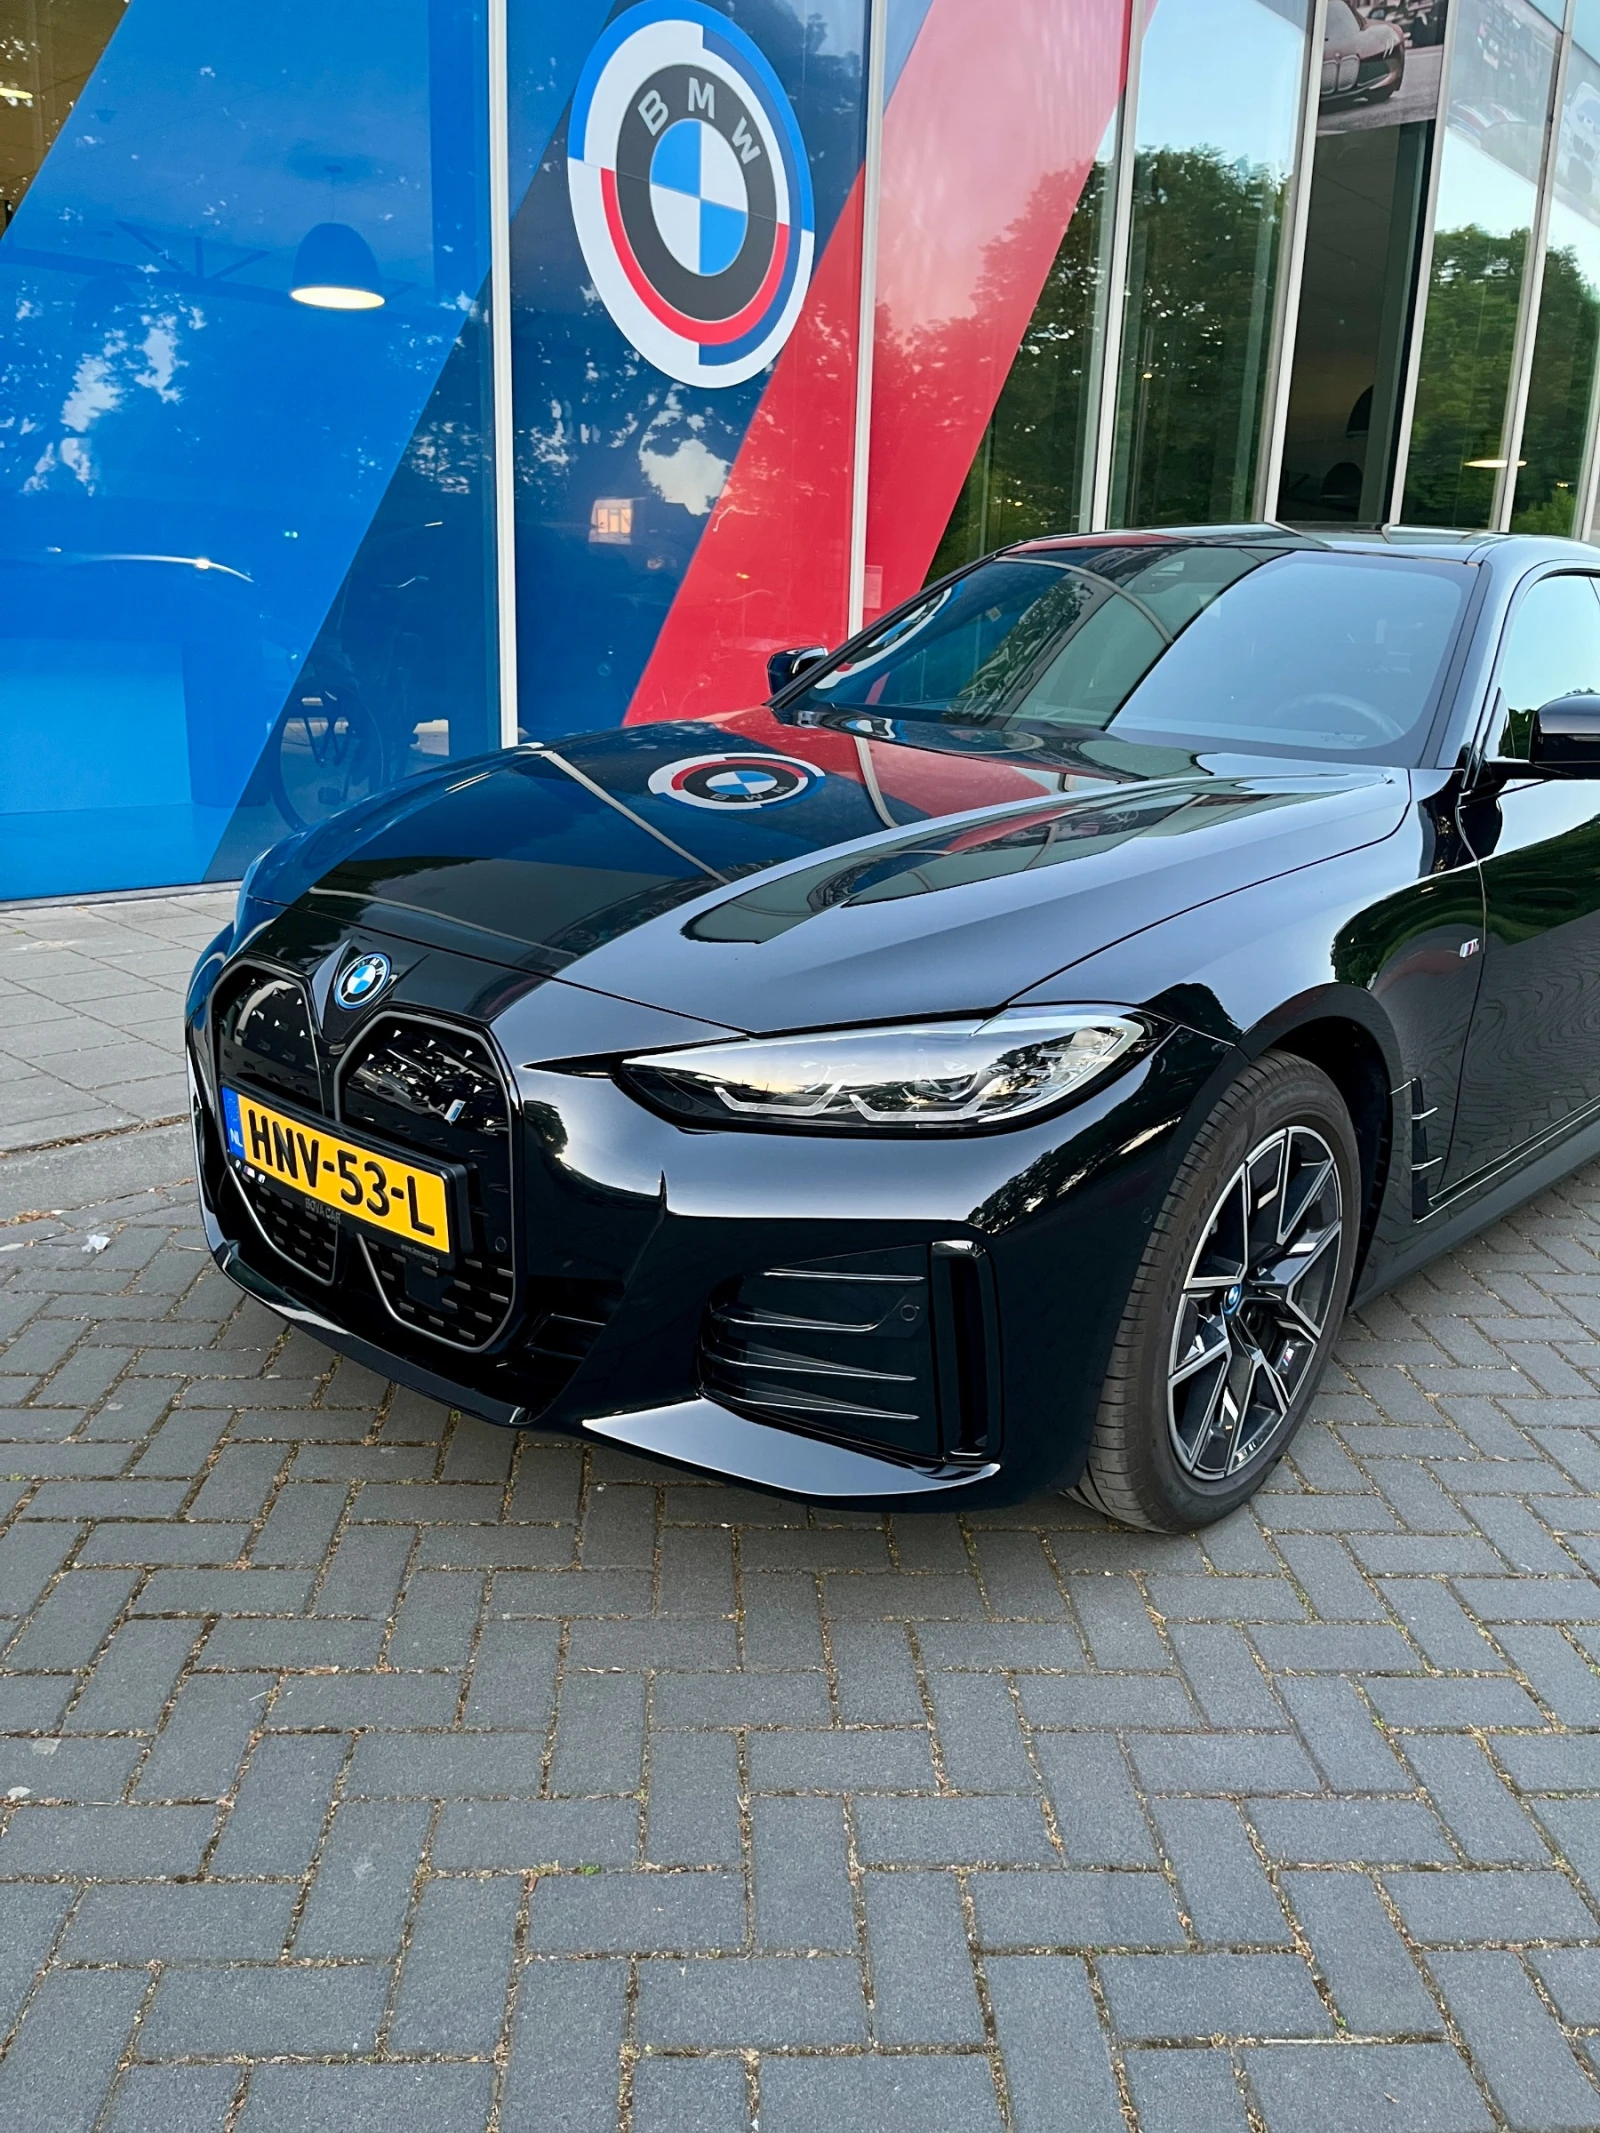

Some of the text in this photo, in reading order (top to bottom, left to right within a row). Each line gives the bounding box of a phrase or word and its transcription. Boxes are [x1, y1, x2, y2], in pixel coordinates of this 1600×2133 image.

[638, 76, 762, 165] BMW
[230, 1127, 244, 1147] NL
[248, 1109, 436, 1237] HNV-53-L
